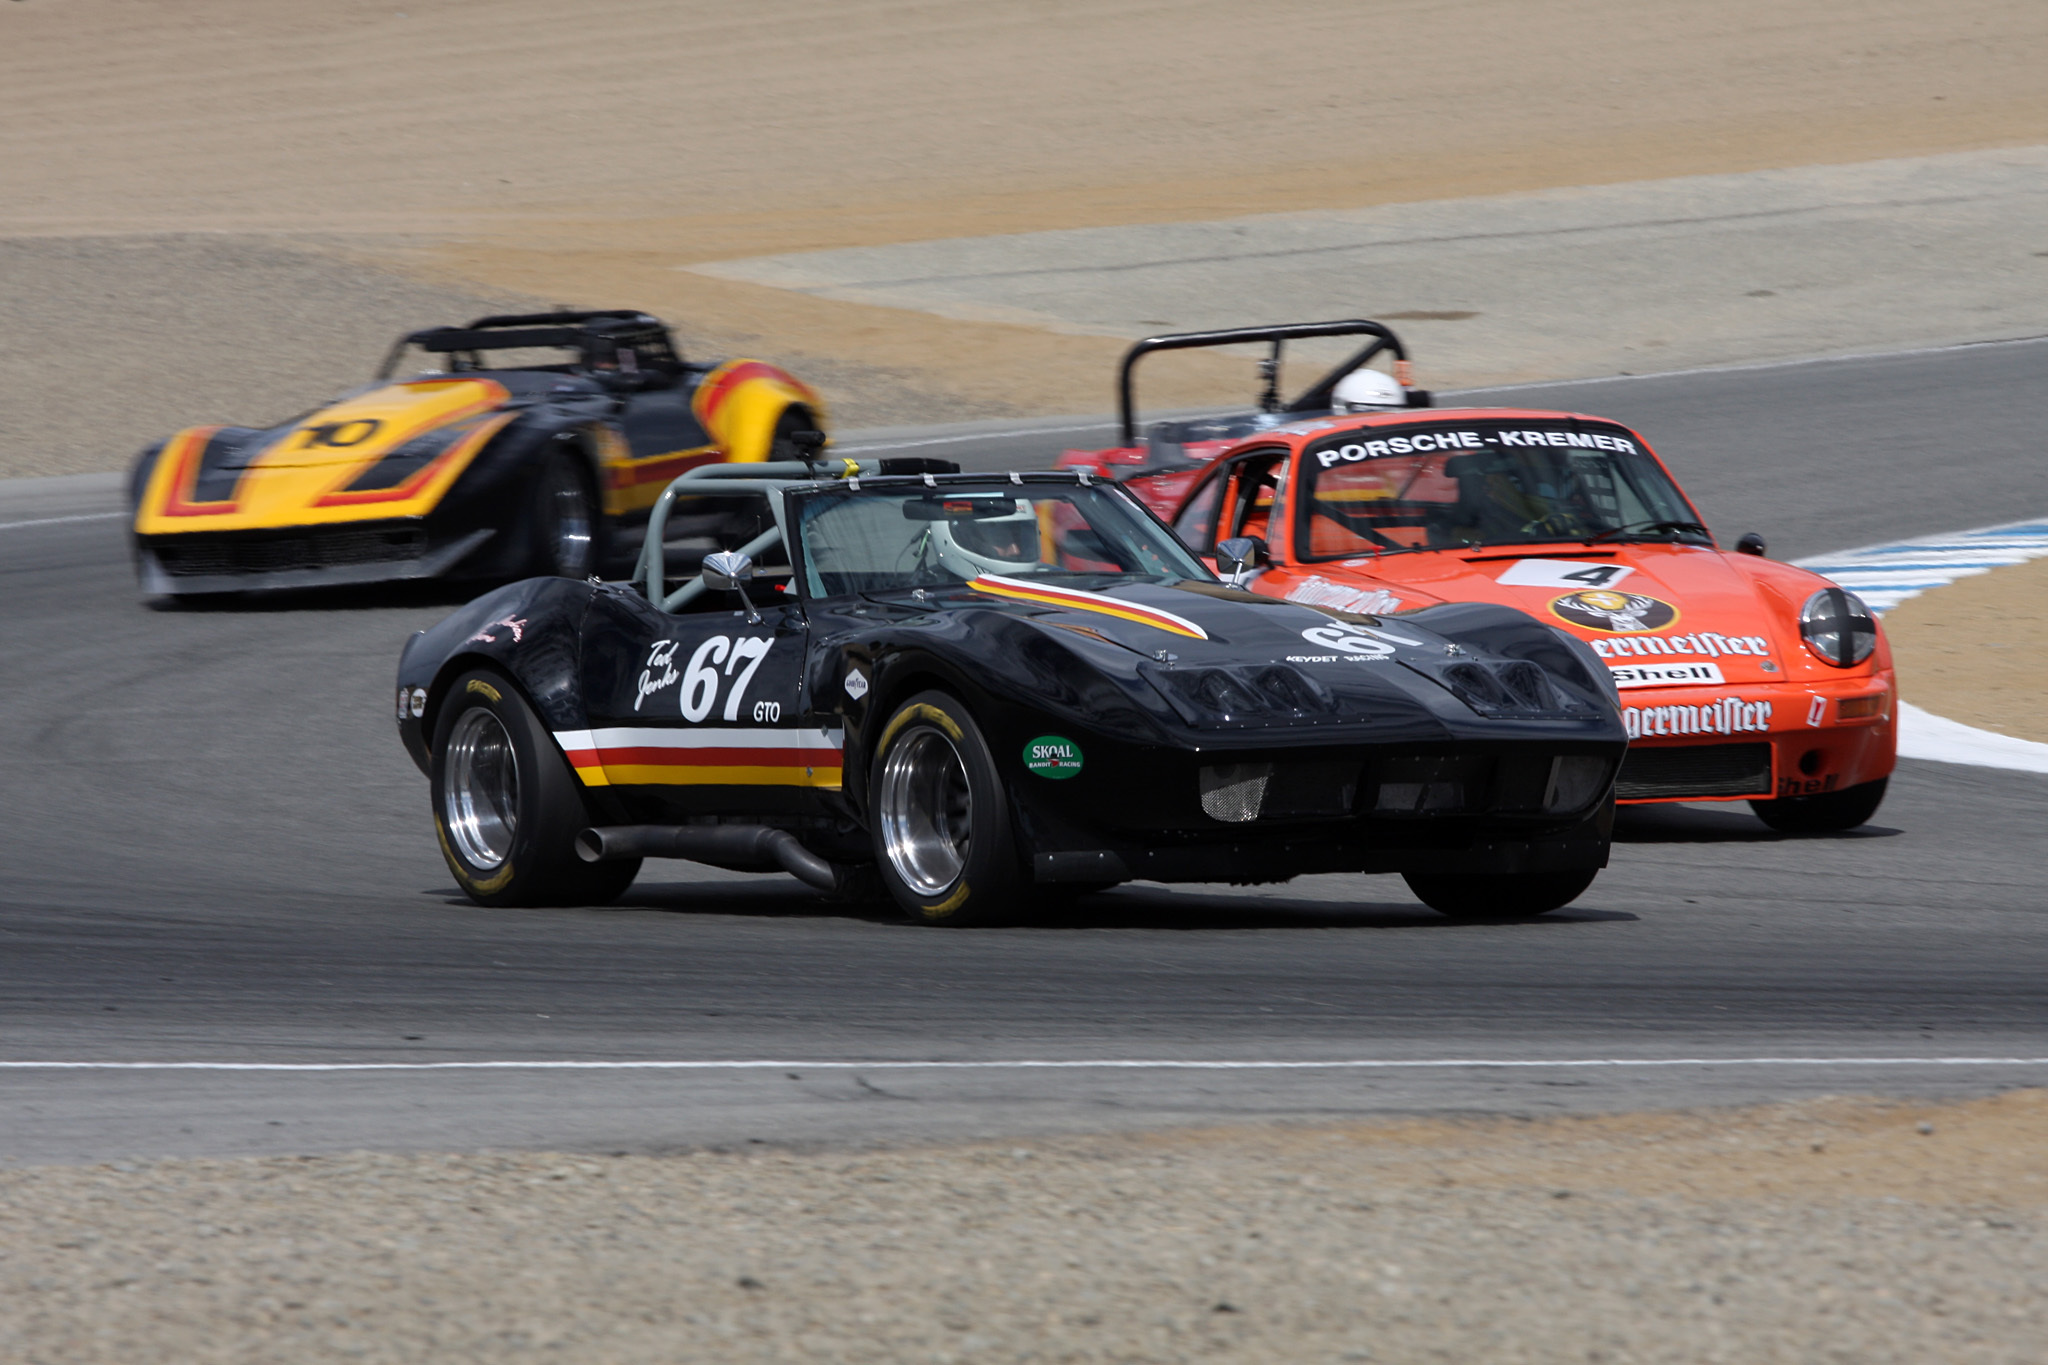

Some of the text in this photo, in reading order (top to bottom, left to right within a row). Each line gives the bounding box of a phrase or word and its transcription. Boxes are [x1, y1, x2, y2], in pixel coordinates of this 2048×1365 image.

[299, 419, 381, 449] 10
[1558, 565, 1624, 587] 4
[1301, 620, 1424, 655] 67
[1588, 632, 1770, 658] ermeister
[647, 639, 679, 667] Ted
[1286, 655, 1338, 663] KEYDET
[680, 635, 775, 723] 67
[1613, 667, 1713, 681] Shell
[753, 701, 781, 722] GTO
[1622, 696, 1773, 740] germeister
[1032, 745, 1074, 759] SKOAL
[1029, 761, 1052, 769] BANDIT
